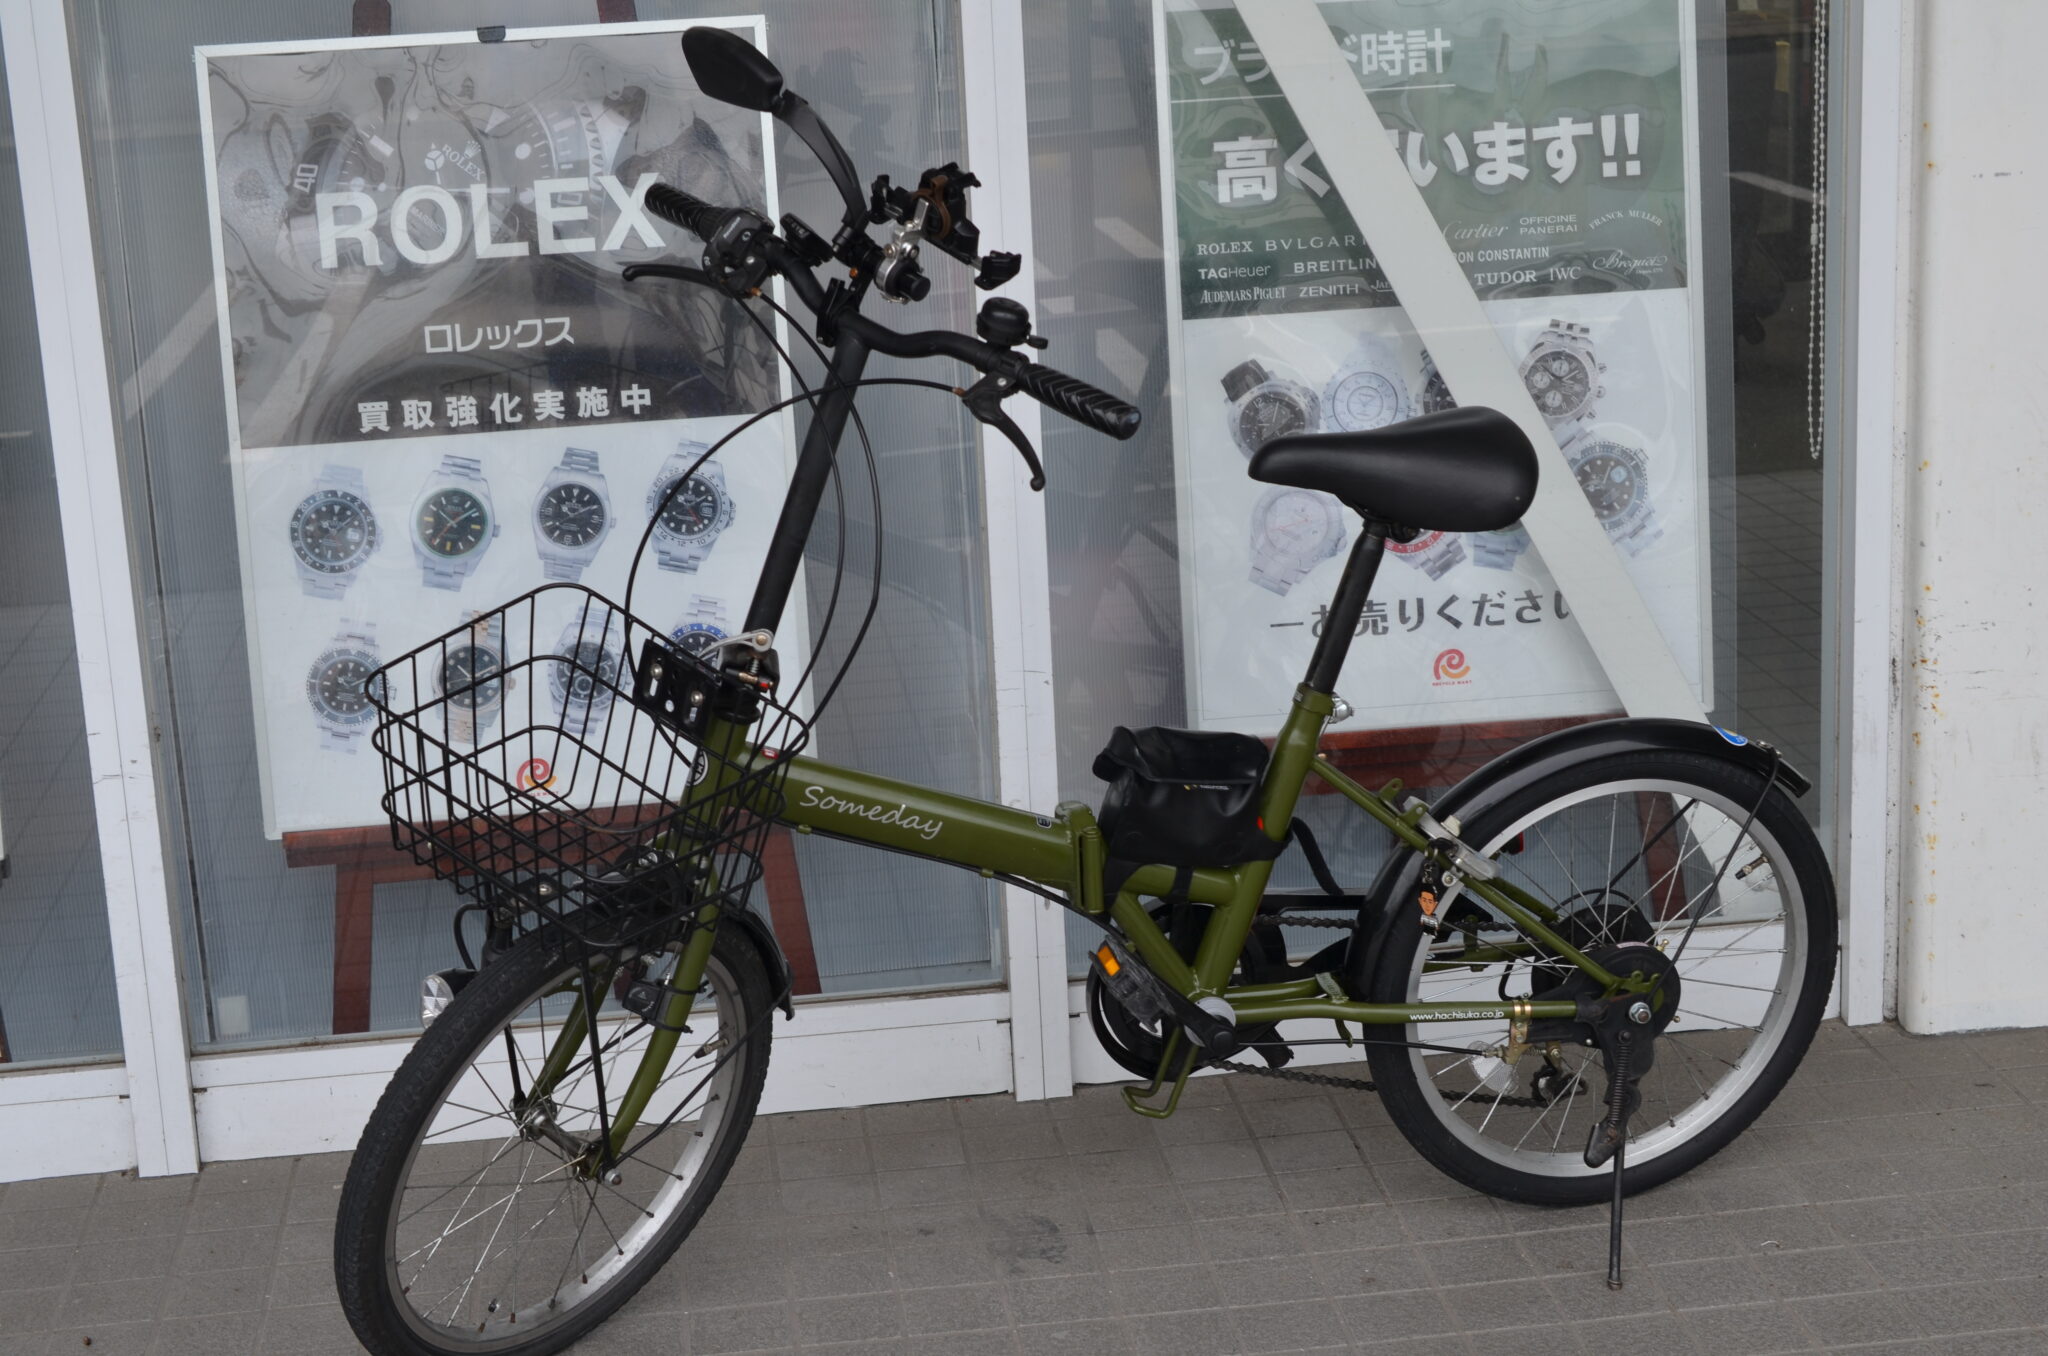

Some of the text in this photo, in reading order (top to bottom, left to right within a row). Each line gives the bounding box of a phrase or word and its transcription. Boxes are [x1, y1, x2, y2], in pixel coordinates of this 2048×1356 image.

[442, 143, 485, 181] ROLEX
[1213, 113, 1642, 204] 高くいます!!
[315, 172, 666, 270] ROLEX
[1519, 214, 1577, 226] OFFICINE
[1519, 224, 1578, 235] PANERAI
[1588, 209, 1664, 230] FRANCK MULLER
[1443, 220, 1509, 240] Cartier
[1197, 241, 1253, 255] ROLEX
[1477, 246, 1550, 262] CONSTANTIN
[1293, 257, 1378, 274] BREITLIN
[1474, 266, 1582, 286] TUDOR IWC
[1201, 287, 1252, 304] AUDEMARS
[1253, 286, 1287, 301] PIGUET
[1299, 283, 1359, 298] ZENITH
[423, 316, 575, 354] ロレックス
[357, 383, 652, 433] 買取強化実施中
[799, 785, 944, 840] Someday
[1409, 1009, 1505, 1021] www.hachisuka.co.jp
